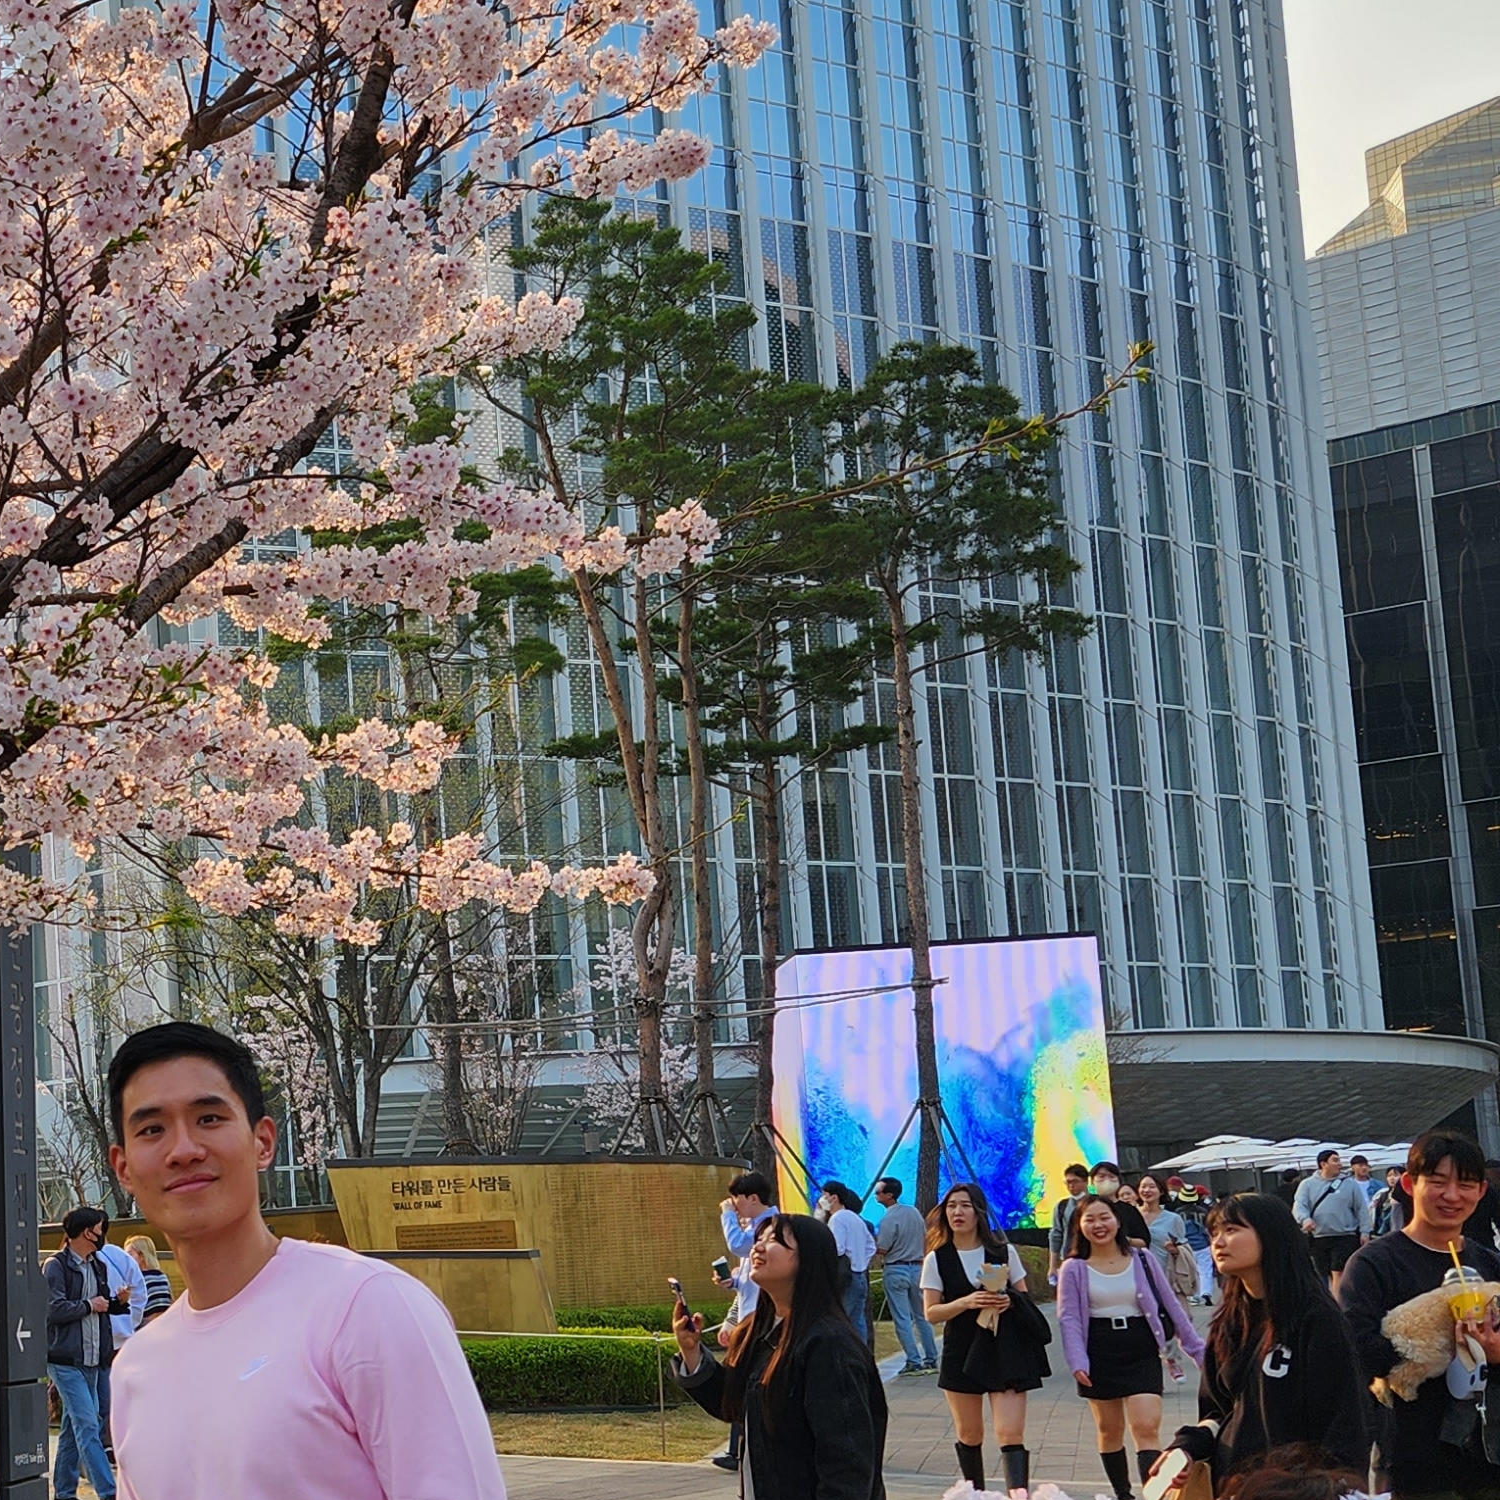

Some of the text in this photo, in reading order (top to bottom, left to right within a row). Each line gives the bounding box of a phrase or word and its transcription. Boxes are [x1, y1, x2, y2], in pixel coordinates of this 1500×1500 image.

[392, 1175, 512, 1197] 타워를 만든 사람들
[393, 1200, 443, 1211] WALL OF FAME
[1262, 1344, 1292, 1378] C
